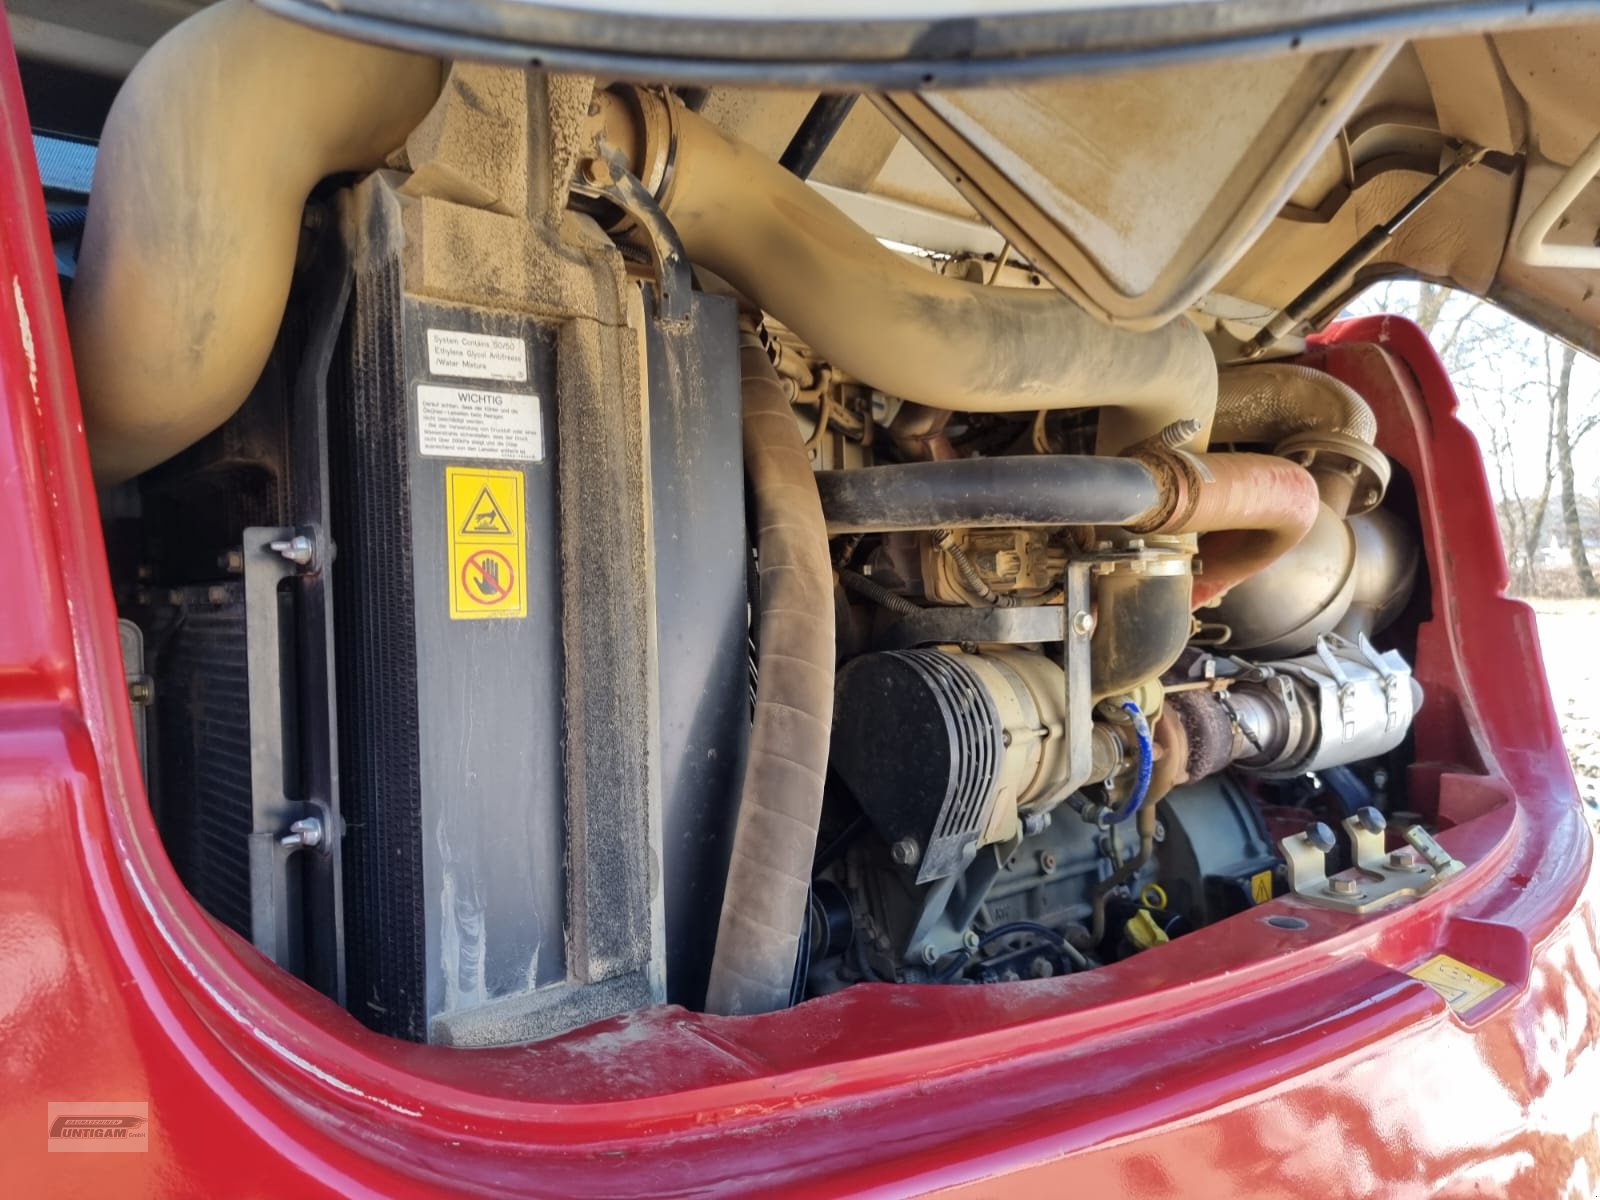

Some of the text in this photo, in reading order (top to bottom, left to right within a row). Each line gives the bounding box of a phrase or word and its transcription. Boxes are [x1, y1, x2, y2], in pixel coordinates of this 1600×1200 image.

[434, 334, 514, 350] System Contains 50/50
[434, 346, 521, 361] Ethylene Glycol Antifreeze
[462, 360, 486, 369] Mixture
[457, 392, 503, 405] WICHTIG
